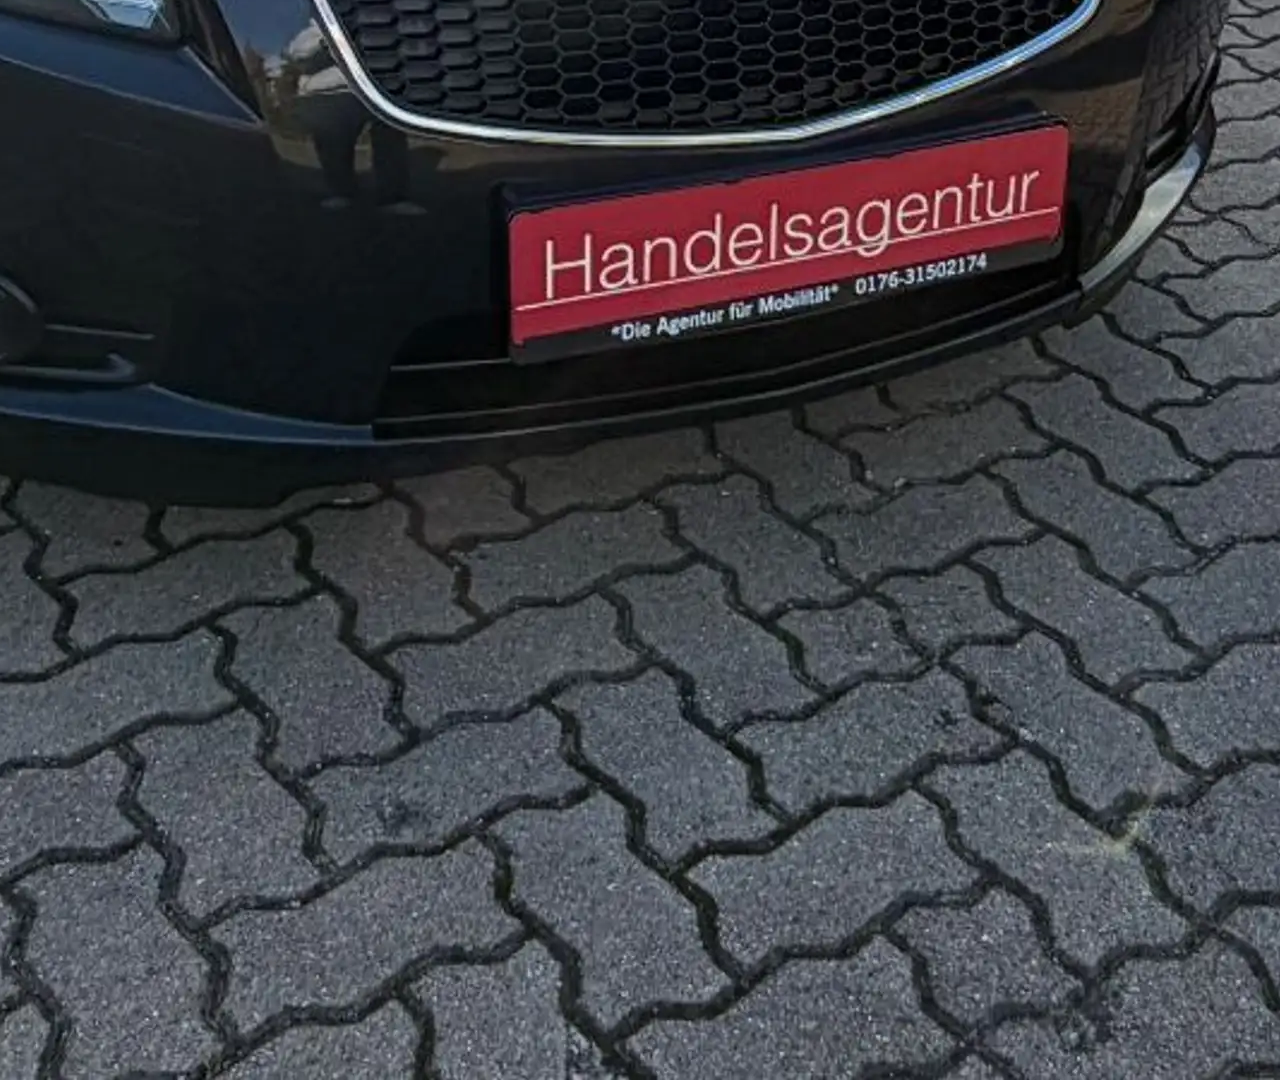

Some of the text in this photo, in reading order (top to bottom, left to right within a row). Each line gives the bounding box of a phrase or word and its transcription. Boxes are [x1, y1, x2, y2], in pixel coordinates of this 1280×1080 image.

[545, 169, 1040, 300] Handelsagentur
[656, 309, 724, 336] Agentur
[729, 301, 753, 321] für
[855, 251, 988, 295] 0176-31502174
